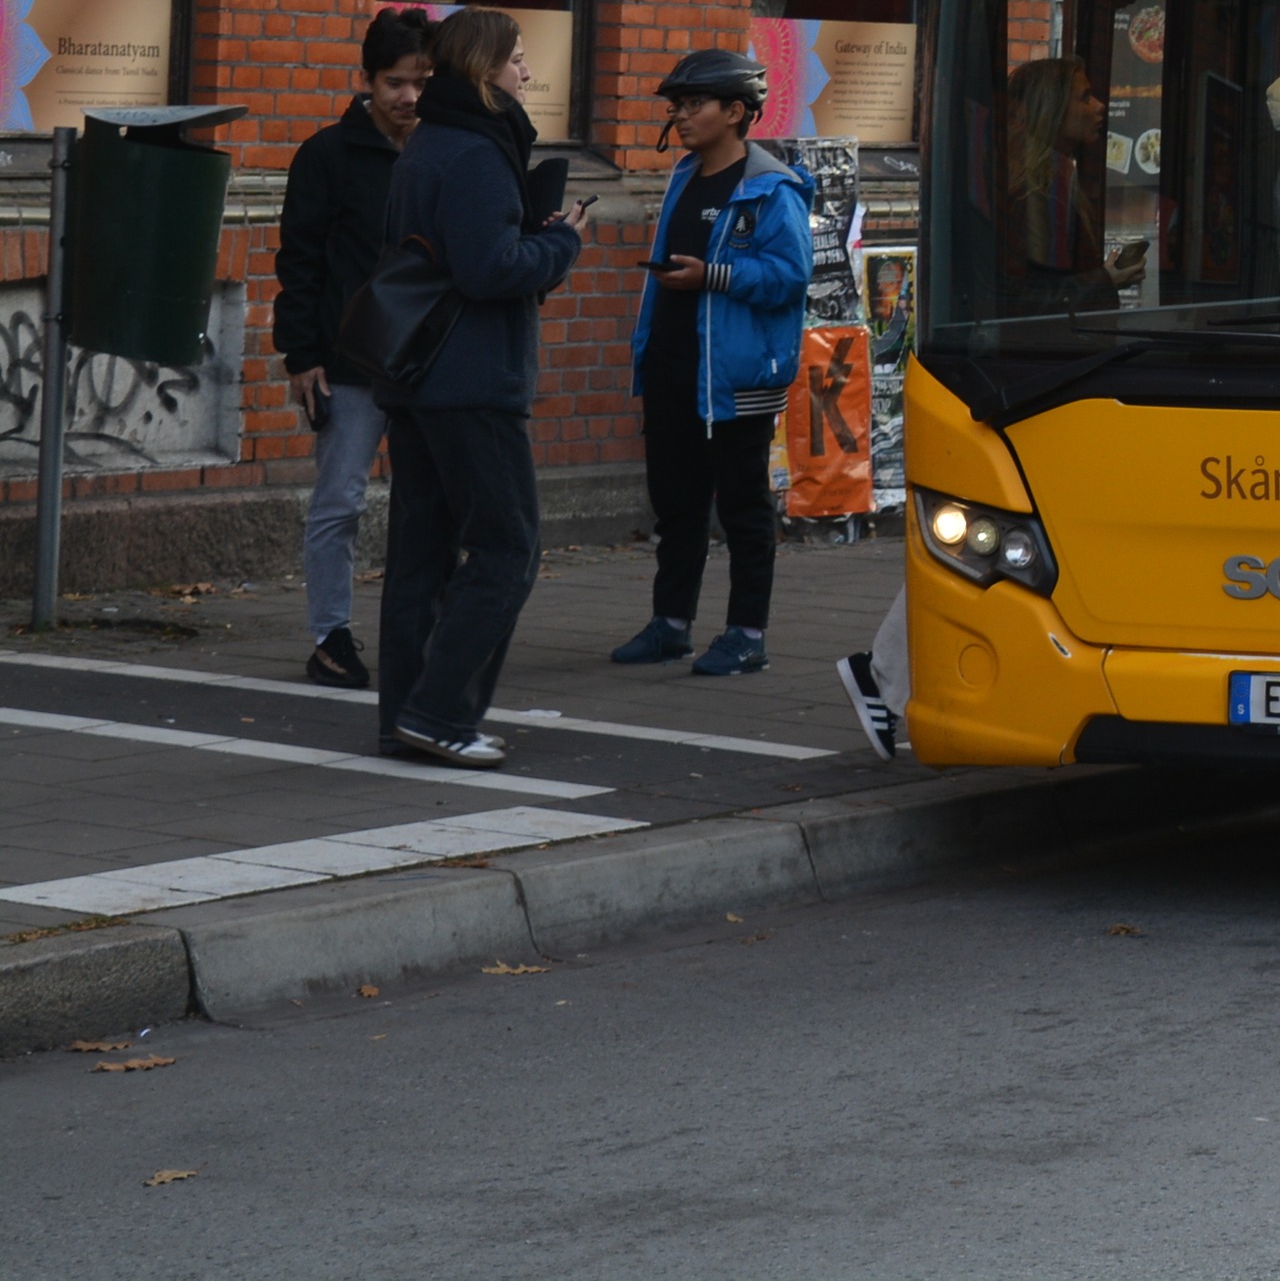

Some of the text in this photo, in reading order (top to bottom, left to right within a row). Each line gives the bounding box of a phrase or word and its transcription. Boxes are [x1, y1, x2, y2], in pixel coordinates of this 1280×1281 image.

[57, 37, 160, 63] Bharatanatyam
[834, 39, 907, 58] Gateway of India
[1237, 704, 1245, 715] S
